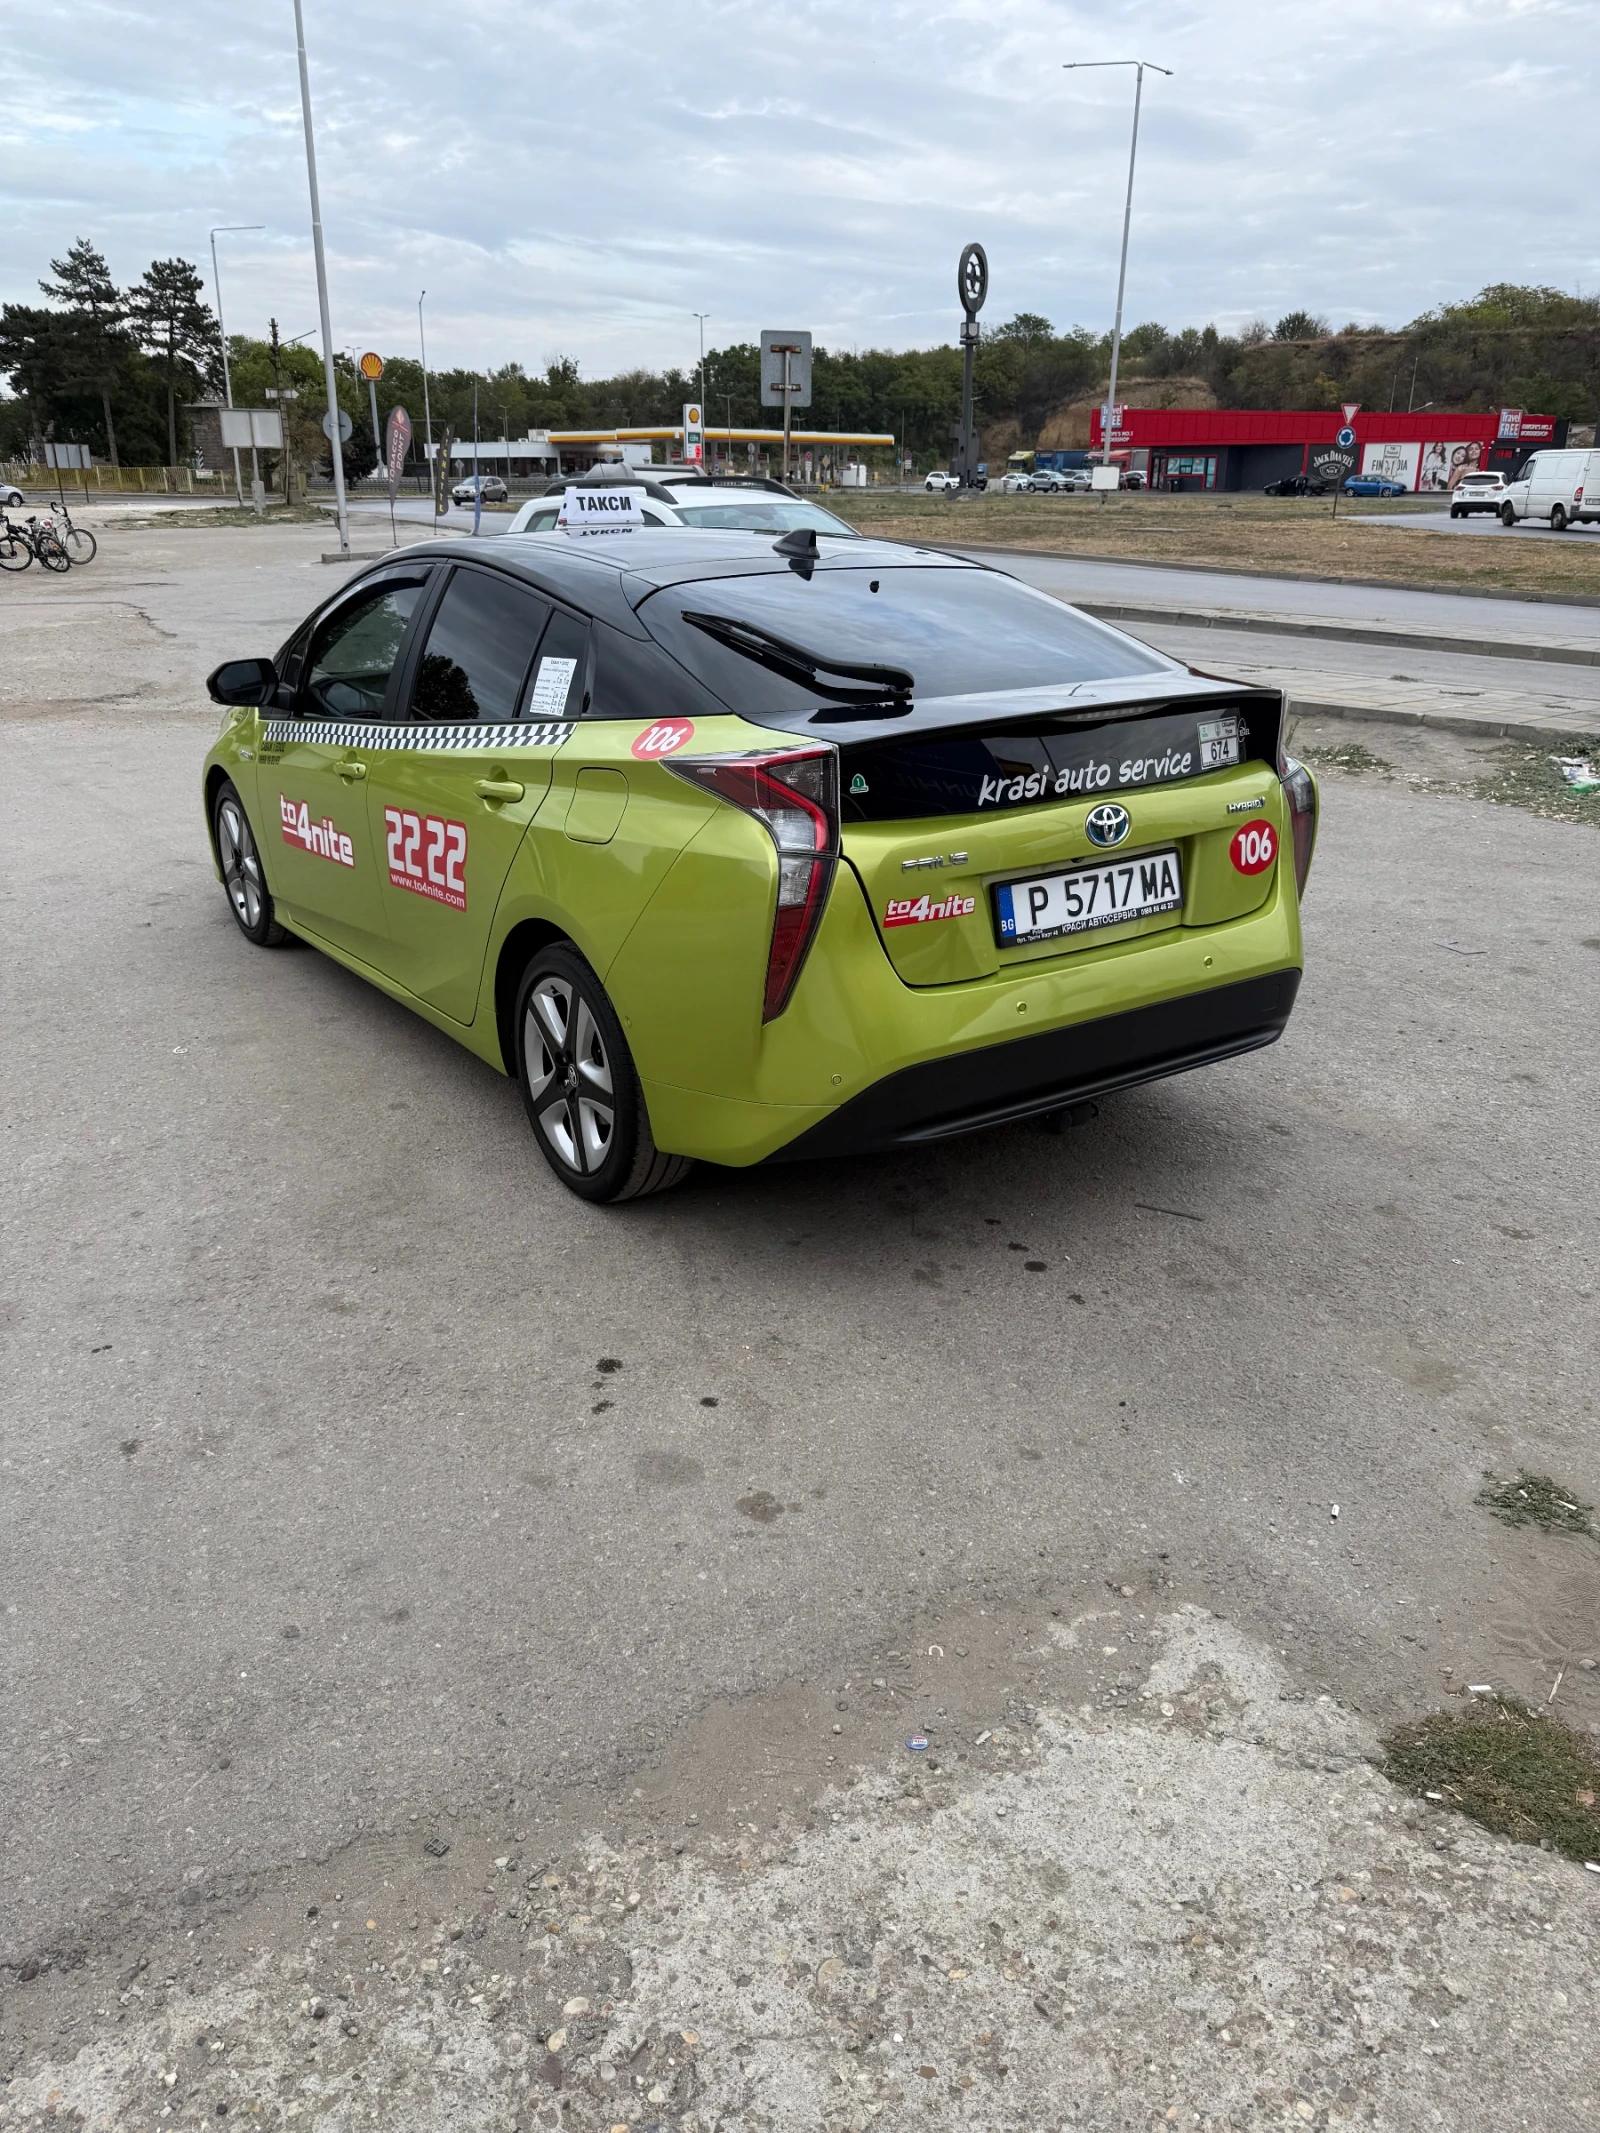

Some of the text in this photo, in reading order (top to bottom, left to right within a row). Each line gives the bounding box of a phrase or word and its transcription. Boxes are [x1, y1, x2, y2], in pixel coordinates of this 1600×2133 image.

[1101, 405, 1122, 415] Trvel
[1101, 415, 1121, 426] FEE
[1502, 411, 1521, 422] Travel
[1500, 423, 1519, 435] FREE
[389, 429, 399, 483] TOBACCO
[396, 433, 405, 470] POINT
[1314, 453, 1329, 467] JACK
[576, 496, 632, 511] ТАКСИ
[637, 726, 688, 752] 106
[1211, 739, 1229, 760] 674
[977, 748, 1192, 807] krasi auto service
[1227, 799, 1263, 814] HYBRID
[280, 794, 355, 867] to4nite
[1238, 827, 1272, 867] 106
[902, 852, 968, 875] PRIUS
[391, 873, 465, 908] www.to4nite.com
[1064, 867, 1134, 917] 5717
[887, 894, 975, 921] to4nite
[1001, 918, 1014, 932] BG
[1062, 909, 1138, 934] КРАСИ АВТОСЕРВИЗ
